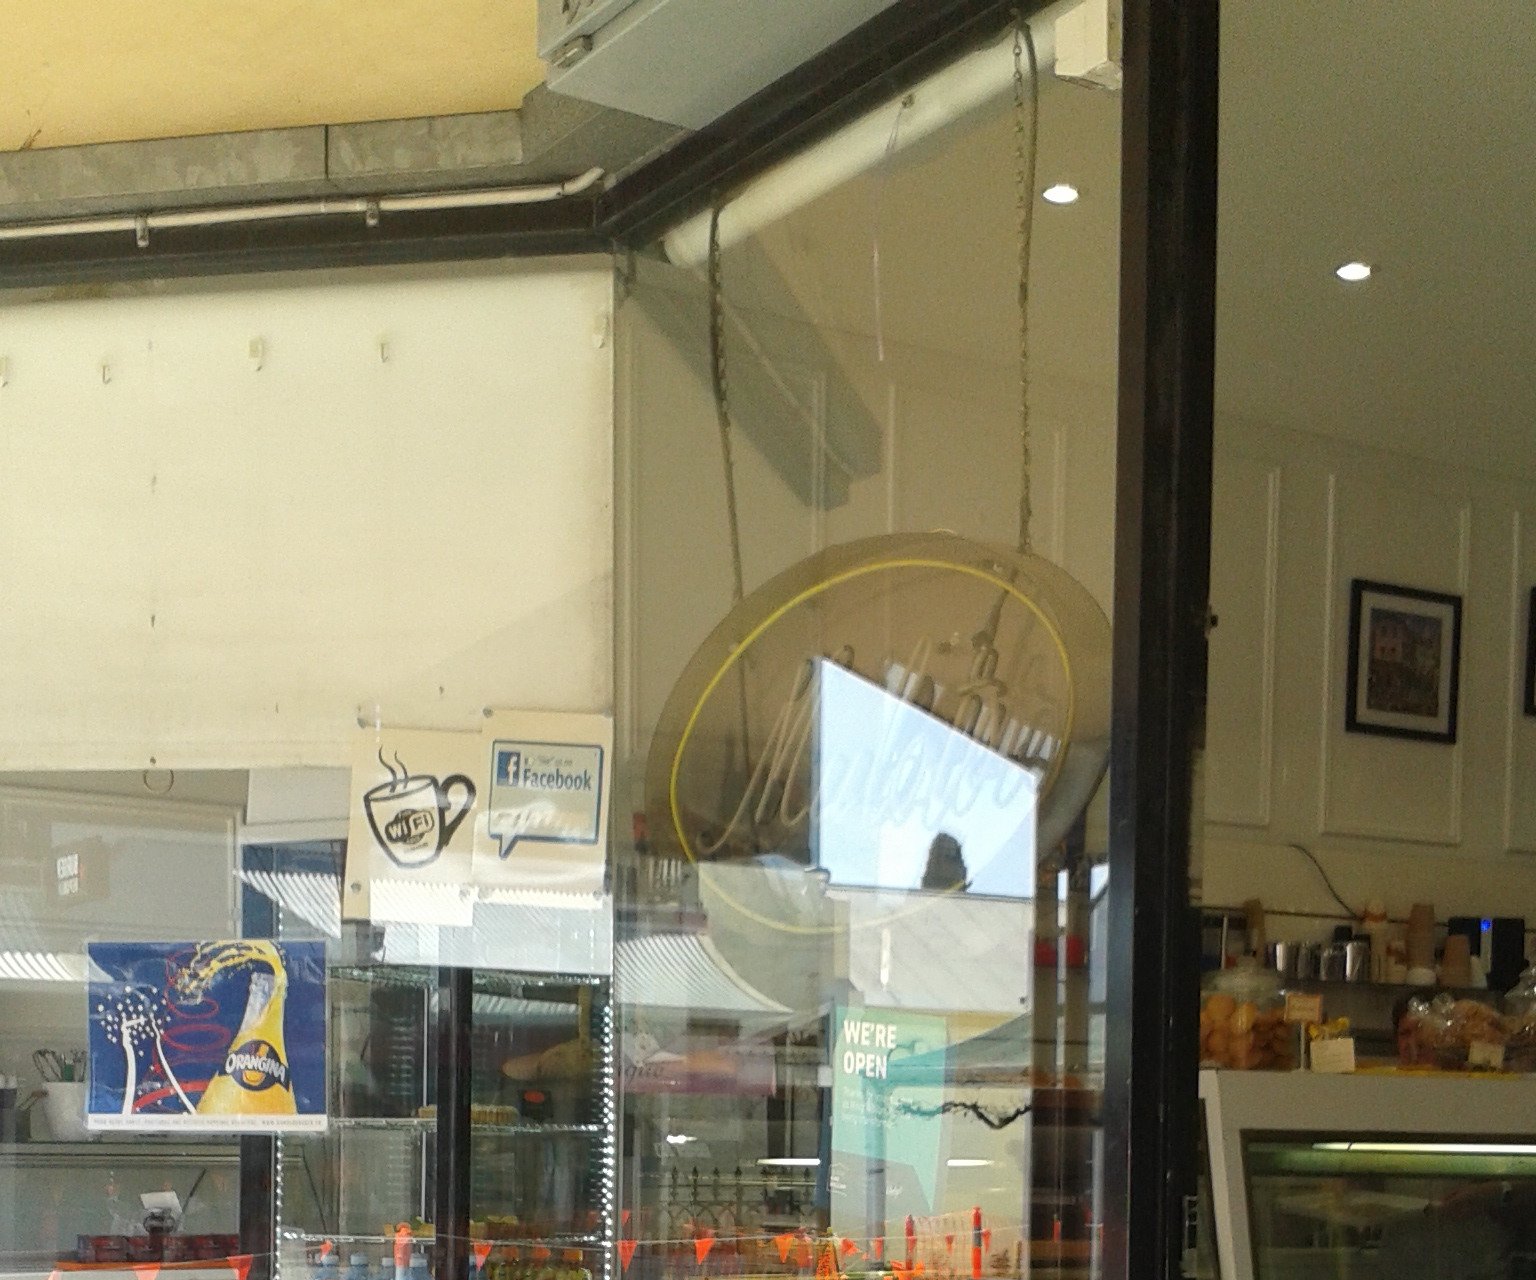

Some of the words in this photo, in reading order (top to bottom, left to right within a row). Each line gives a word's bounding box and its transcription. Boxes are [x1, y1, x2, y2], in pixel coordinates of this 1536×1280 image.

[523, 767, 592, 791] Facebook
[843, 1019, 898, 1049] WE'RE
[224, 1053, 286, 1084] ORANGINA
[843, 1051, 888, 1079] OPEN
